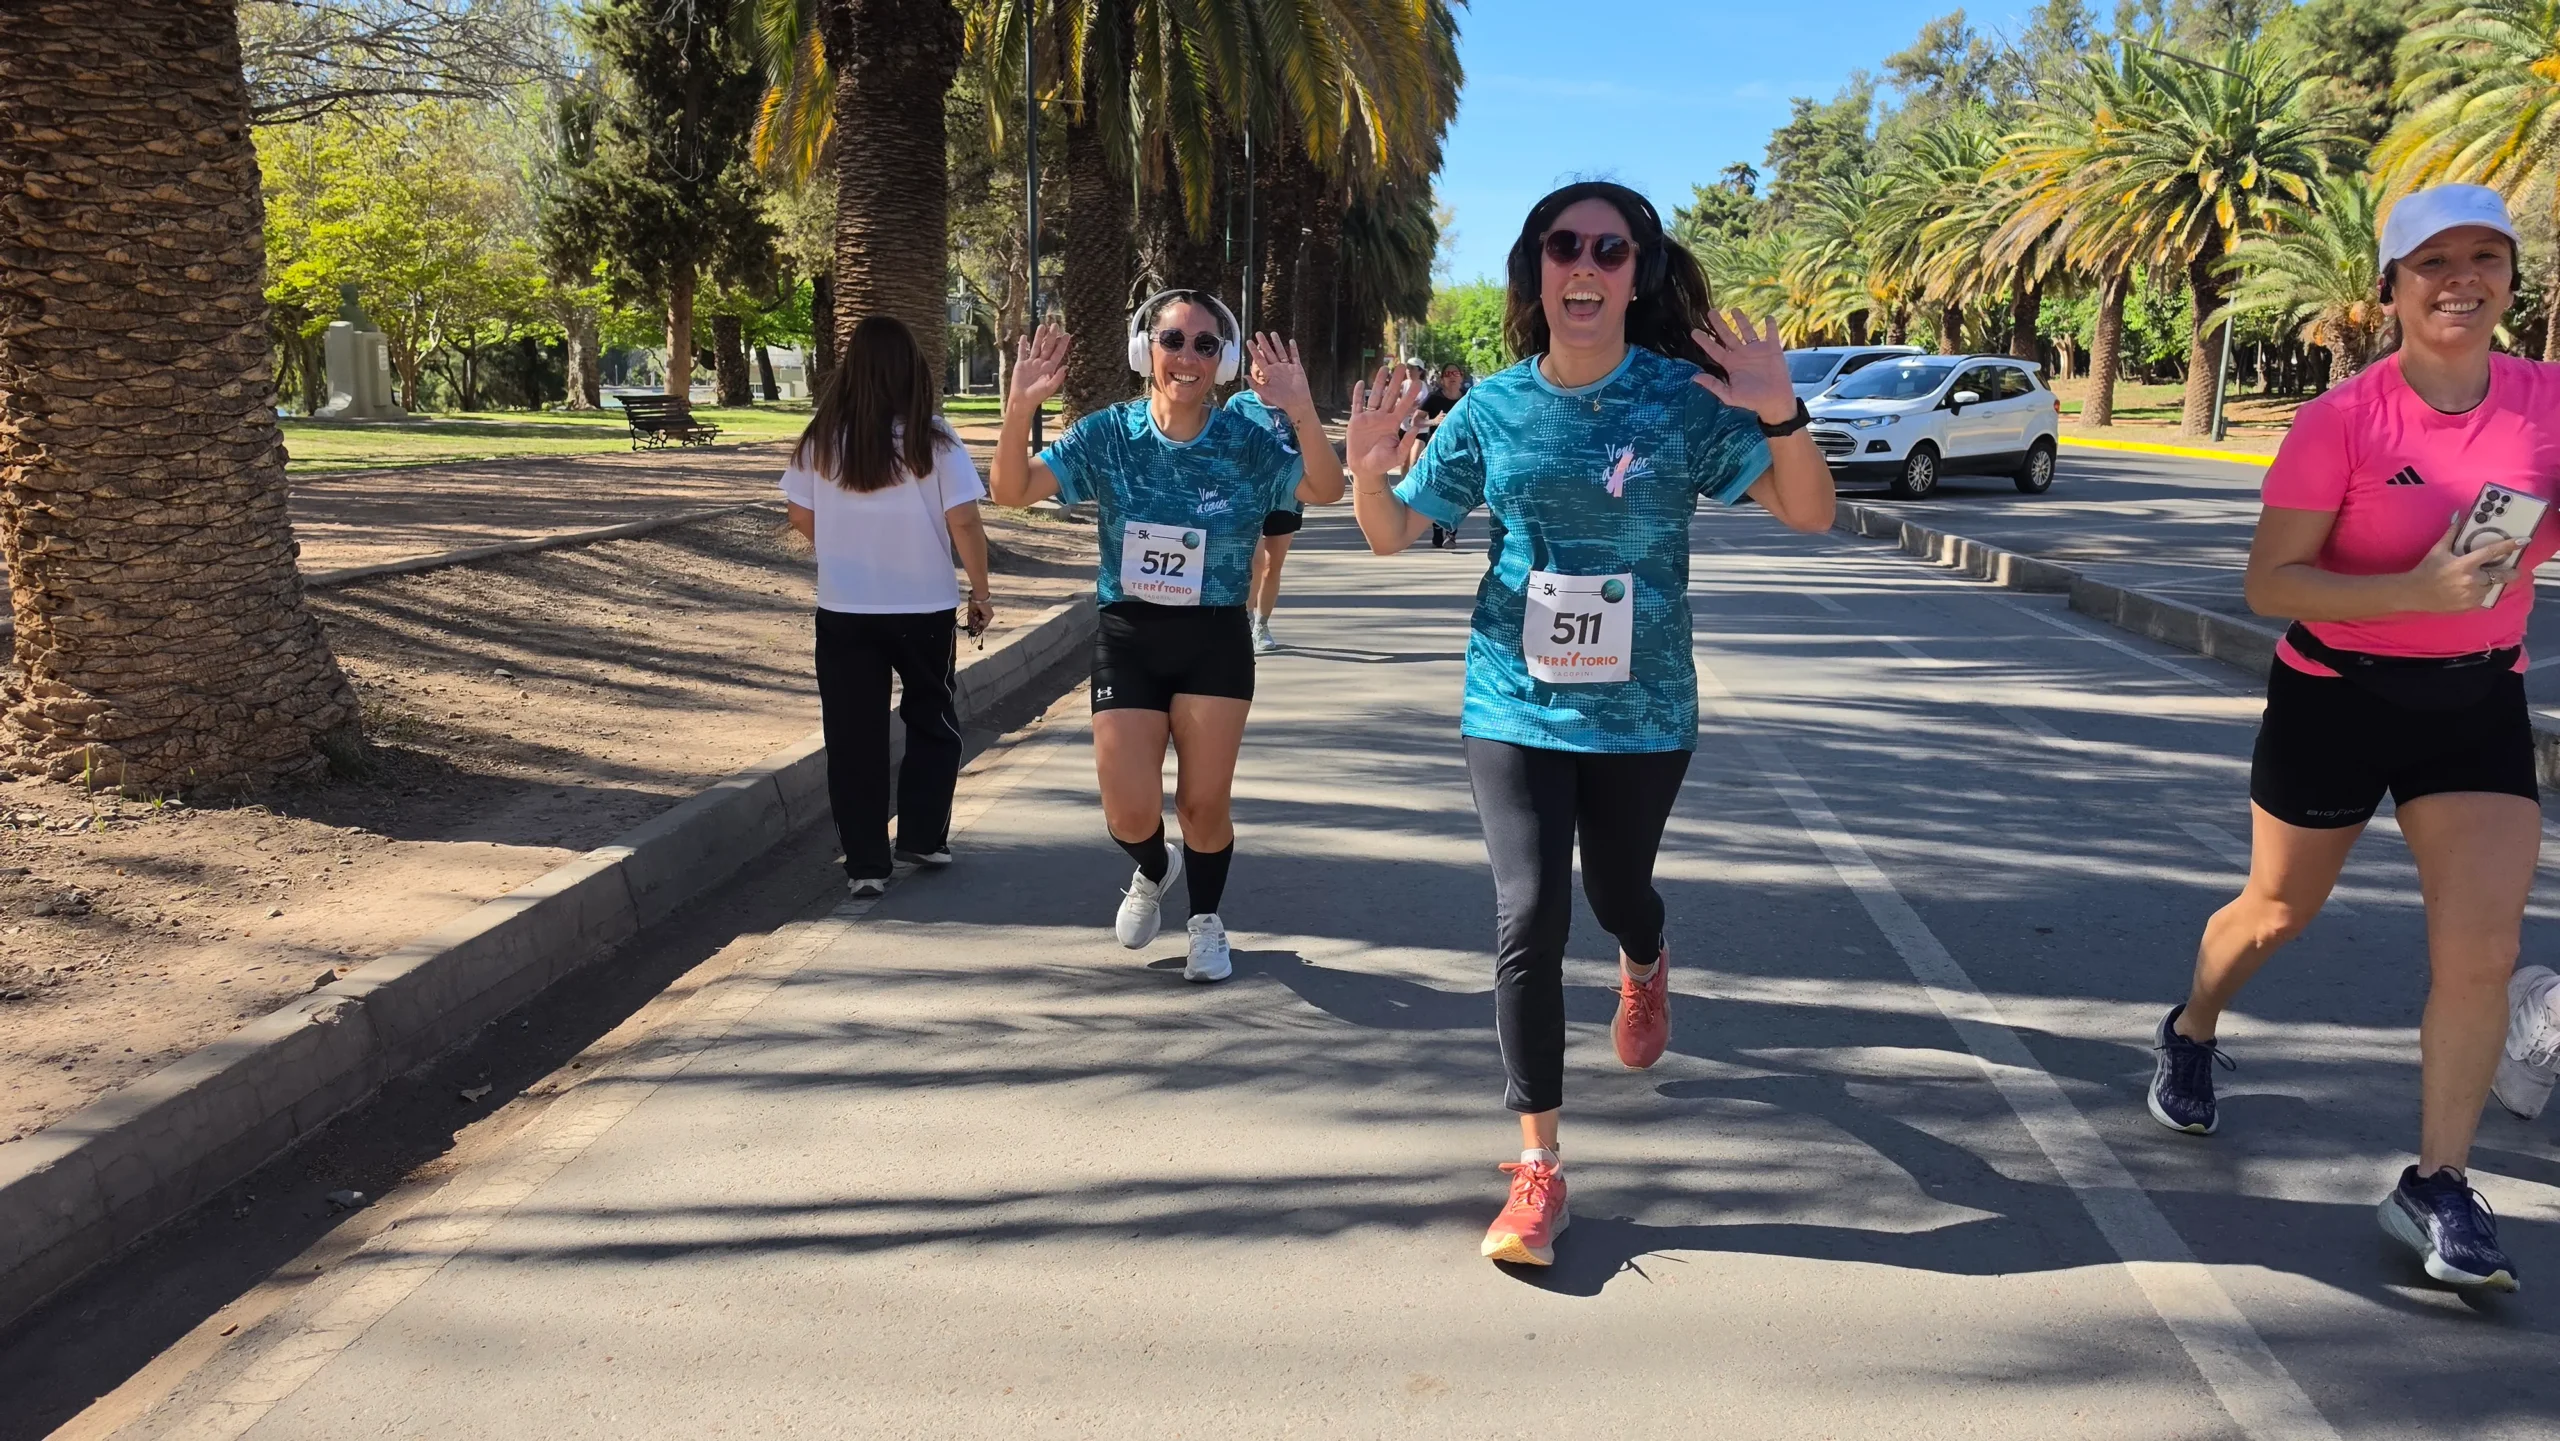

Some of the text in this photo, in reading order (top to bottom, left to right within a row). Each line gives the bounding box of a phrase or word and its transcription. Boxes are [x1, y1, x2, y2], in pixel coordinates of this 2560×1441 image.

[1138, 529, 1150, 540] 5k
[1140, 550, 1186, 577] 512
[1132, 580, 1192, 594] TERRITORIO
[1543, 583, 1557, 597] 5k
[1550, 612, 1603, 645] 511
[1536, 651, 1618, 667] TERRITORIO
